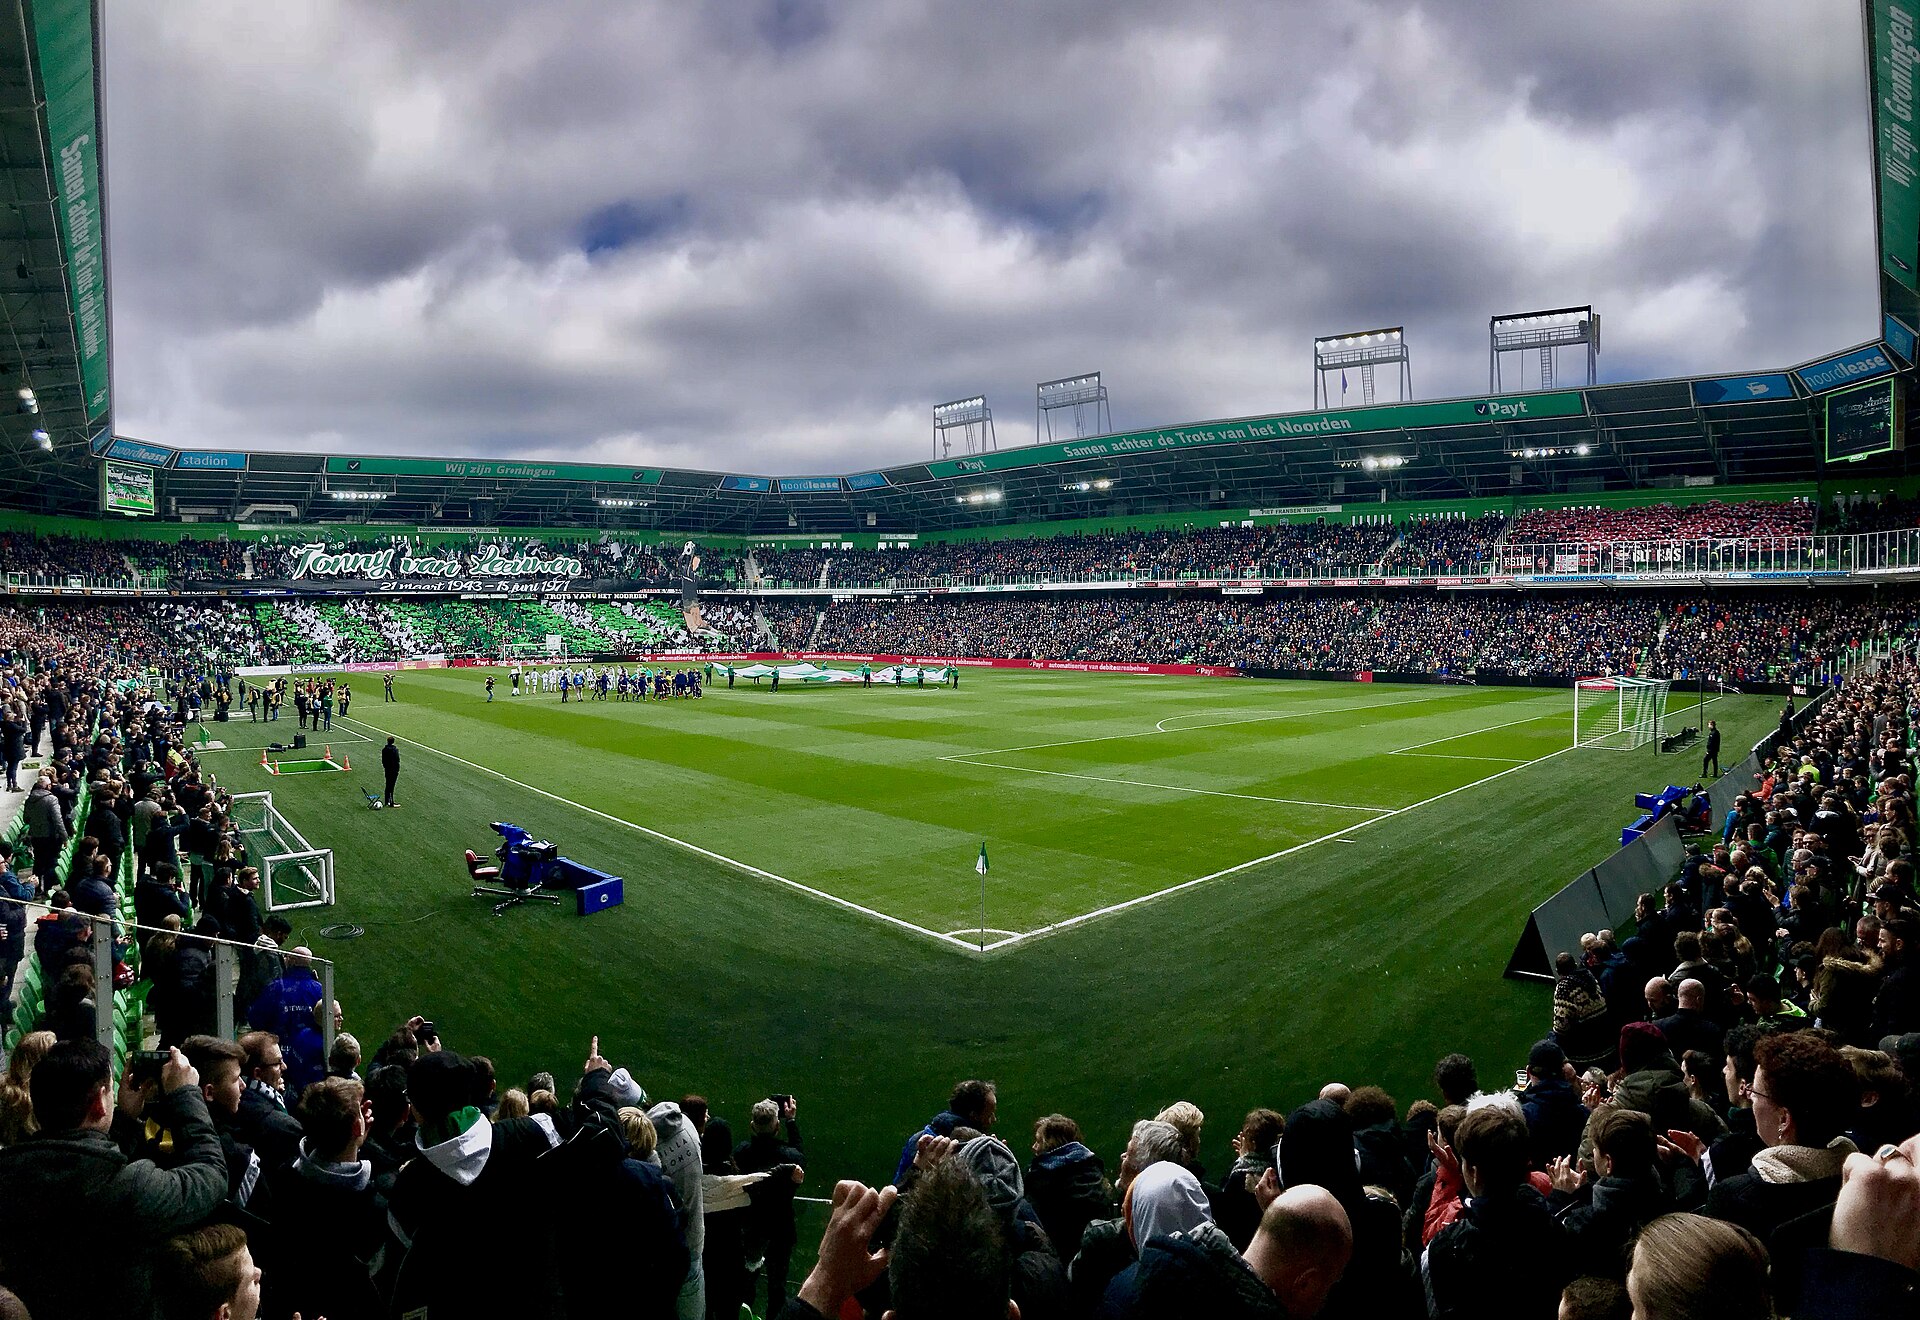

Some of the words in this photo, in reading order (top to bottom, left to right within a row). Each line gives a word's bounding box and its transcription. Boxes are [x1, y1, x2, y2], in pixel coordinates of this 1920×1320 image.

[1884, 6, 1920, 122] Groningen
[1884, 122, 1919, 160] zijn
[60, 134, 90, 204] Samen
[1886, 151, 1918, 188] Wij
[67, 199, 95, 248] achter
[74, 241, 97, 267] de
[76, 256, 98, 295] Trots
[1804, 354, 1888, 388] noordlease
[1489, 401, 1528, 416] Payt
[1063, 444, 1108, 458] Samen
[1112, 437, 1153, 451] achter
[1157, 434, 1174, 447] de
[1175, 430, 1215, 445] Trots
[1218, 429, 1246, 441] van
[1250, 423, 1276, 437] het
[1278, 417, 1352, 434] Noorden
[112, 444, 168, 463] noordlease
[183, 454, 228, 466] stadion
[445, 463, 466, 475] Wij
[469, 464, 492, 475] zijn
[496, 464, 556, 478] Groningen
[964, 459, 987, 472] Payt
[781, 479, 839, 490] noordlease
[289, 542, 396, 580] Tonny
[400, 555, 462, 577] van
[469, 544, 582, 577] Leeuwen
[381, 581, 397, 591] 21
[398, 580, 447, 591] maart
[447, 580, 483, 592] 1943
[508, 581, 539, 593] juni
[541, 579, 571, 592] 1971
[639, 655, 652, 663] Payt
[1032, 661, 1044, 669] Payt
[1048, 662, 1088, 671] automatisering
[1099, 662, 1150, 672] debiteurenbeheer
[1200, 667, 1215, 676] Payt
[1793, 685, 1808, 695] Wat
